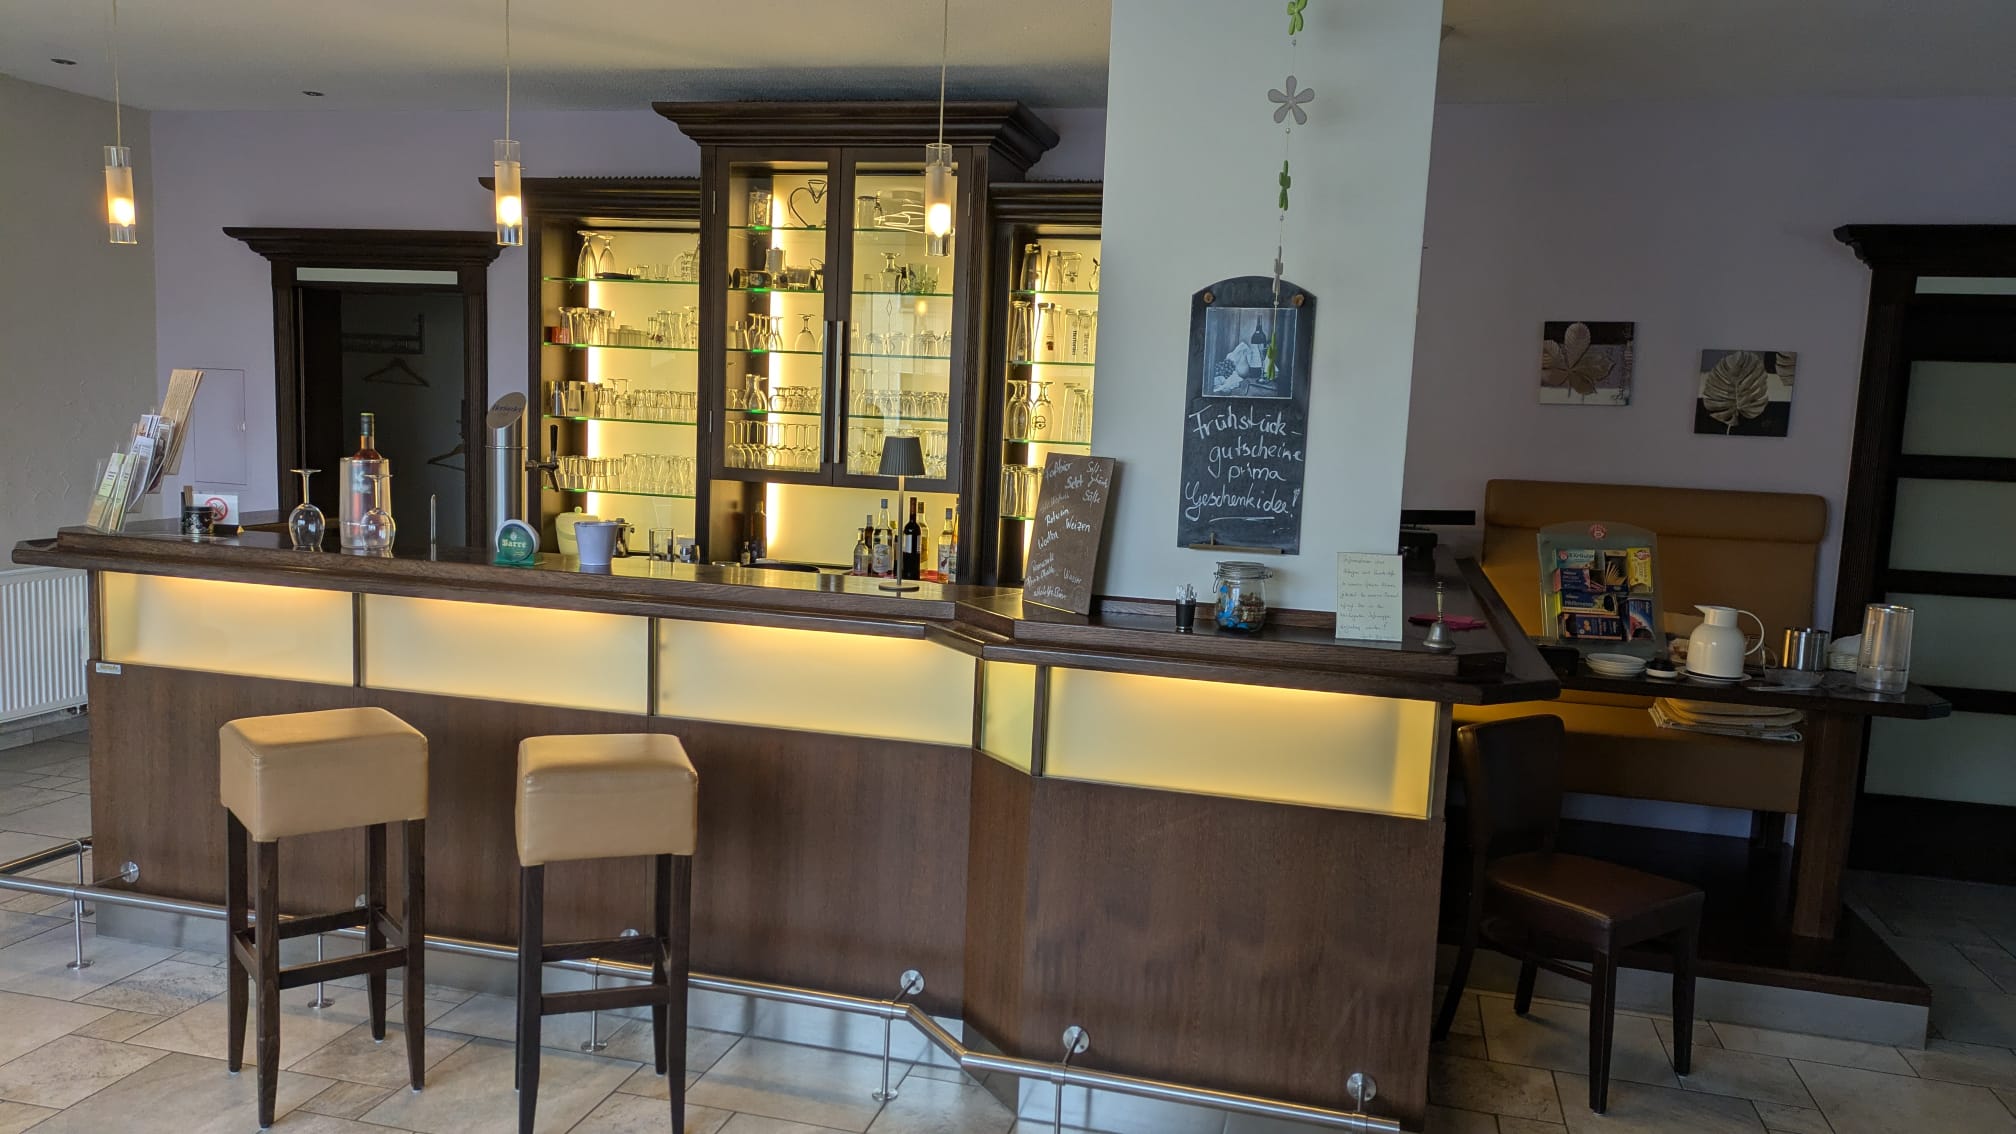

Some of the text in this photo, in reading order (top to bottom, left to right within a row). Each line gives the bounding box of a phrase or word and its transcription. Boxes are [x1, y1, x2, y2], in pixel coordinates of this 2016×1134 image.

[1207, 434, 1304, 479] gutscheine
[1228, 462, 1287, 483] prima
[1065, 515, 1091, 532] Weizen
